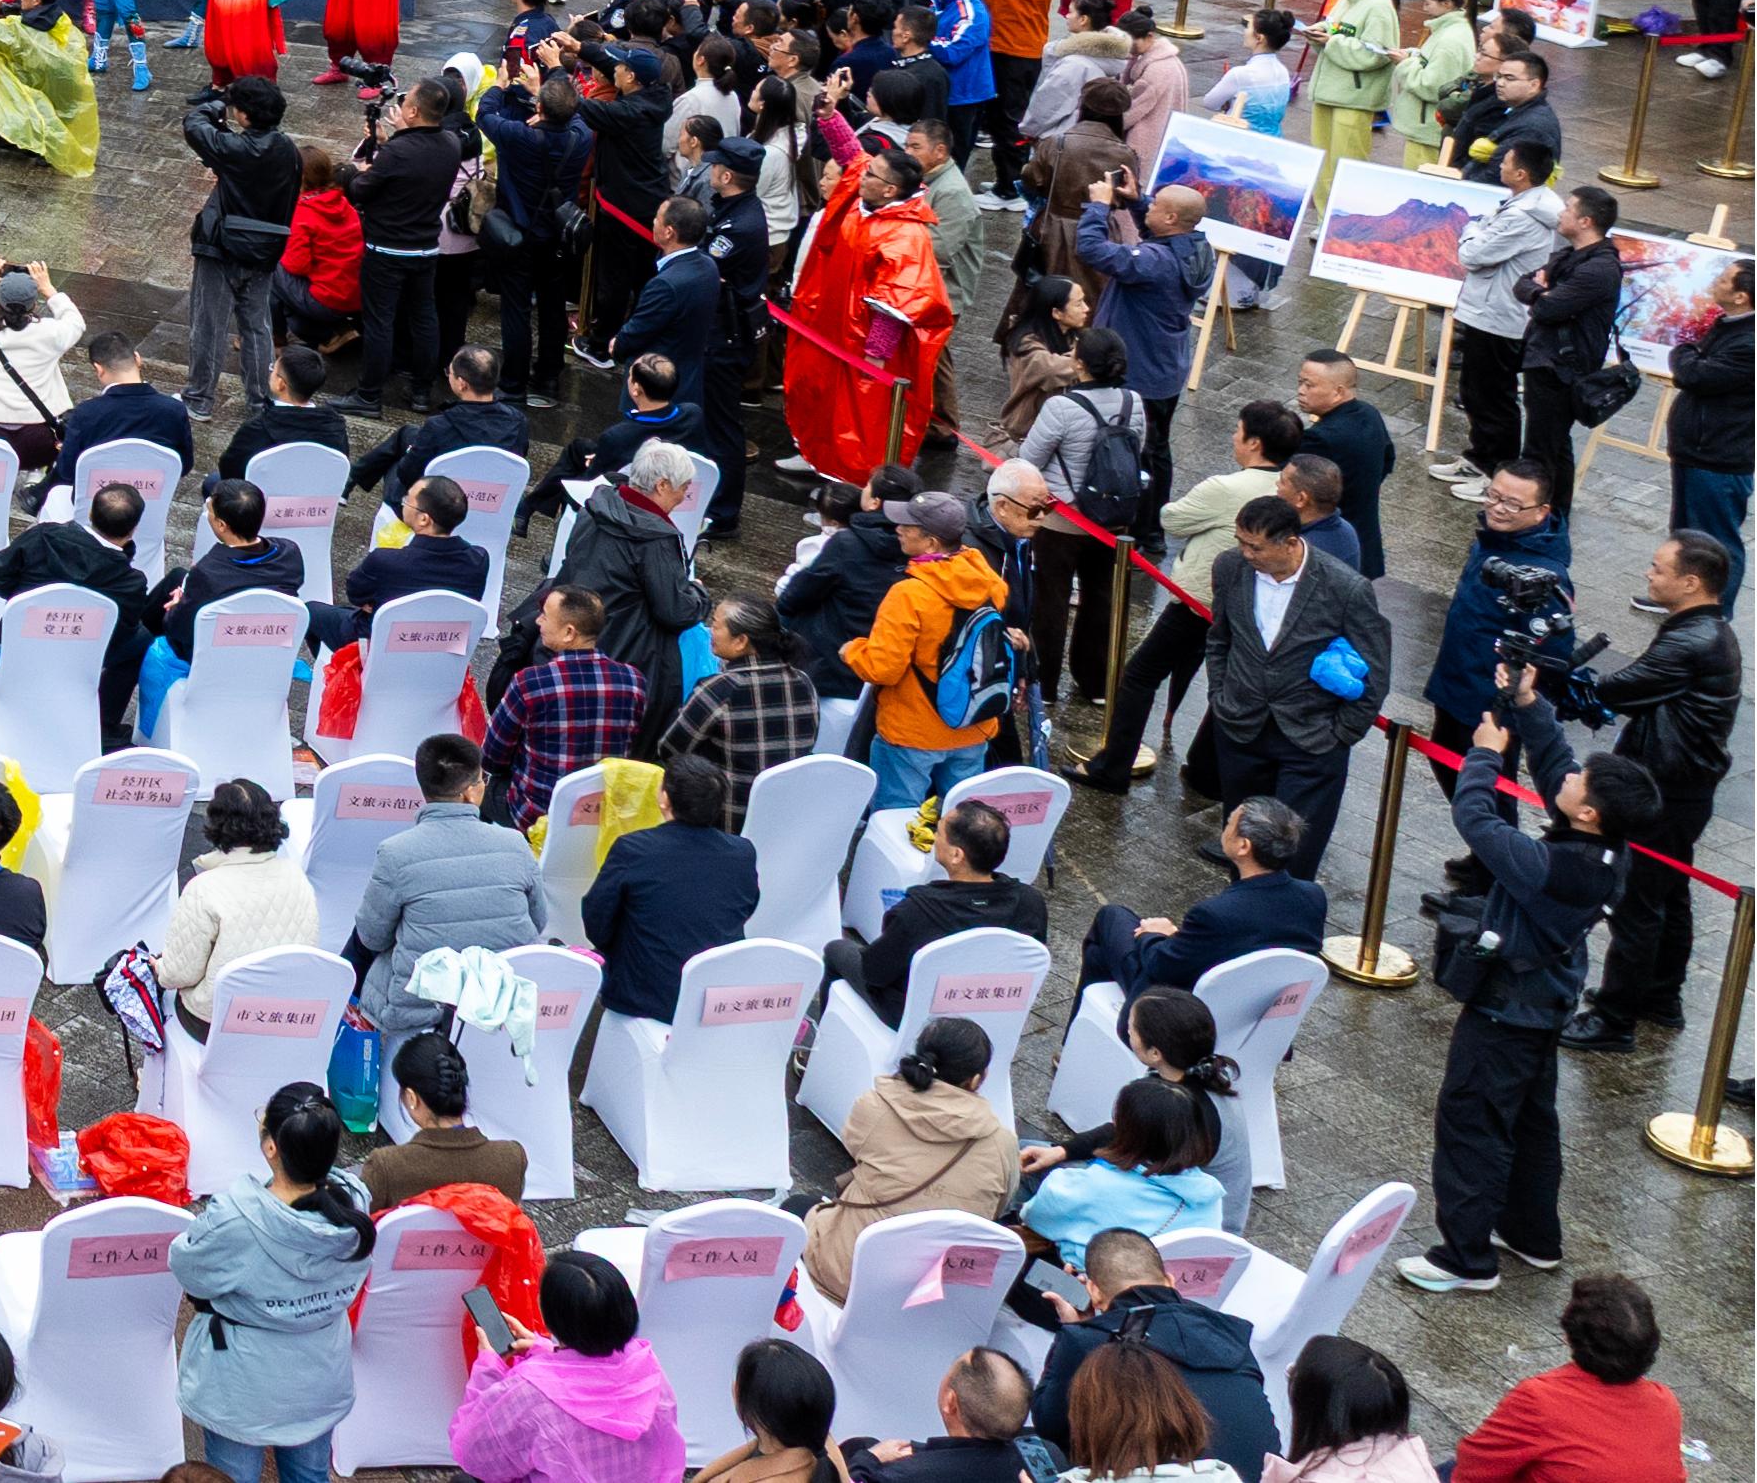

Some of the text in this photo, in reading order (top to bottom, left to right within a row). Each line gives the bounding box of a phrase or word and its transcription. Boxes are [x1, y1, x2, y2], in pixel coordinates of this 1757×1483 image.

[464, 492, 500, 503] 示范区
[273, 506, 329, 518] 文旅示范区
[46, 611, 84, 622] 经开区
[45, 624, 82, 634] 党工委
[223, 624, 288, 635] 文旅示范区
[398, 631, 461, 642] 文旅示范区
[121, 777, 161, 787] 经开区
[106, 790, 172, 802] 社会事务局
[348, 796, 422, 808] 文旅示范区
[944, 987, 1022, 1000] 市文旅集团
[714, 997, 792, 1013] 市文旅集团
[237, 1011, 316, 1024] 市文旅集团
[90, 1248, 158, 1263] 工作人员
[415, 1245, 486, 1256] 工作人员
[690, 1251, 758, 1263] 工作人员
[1178, 1270, 1205, 1283] 人员
